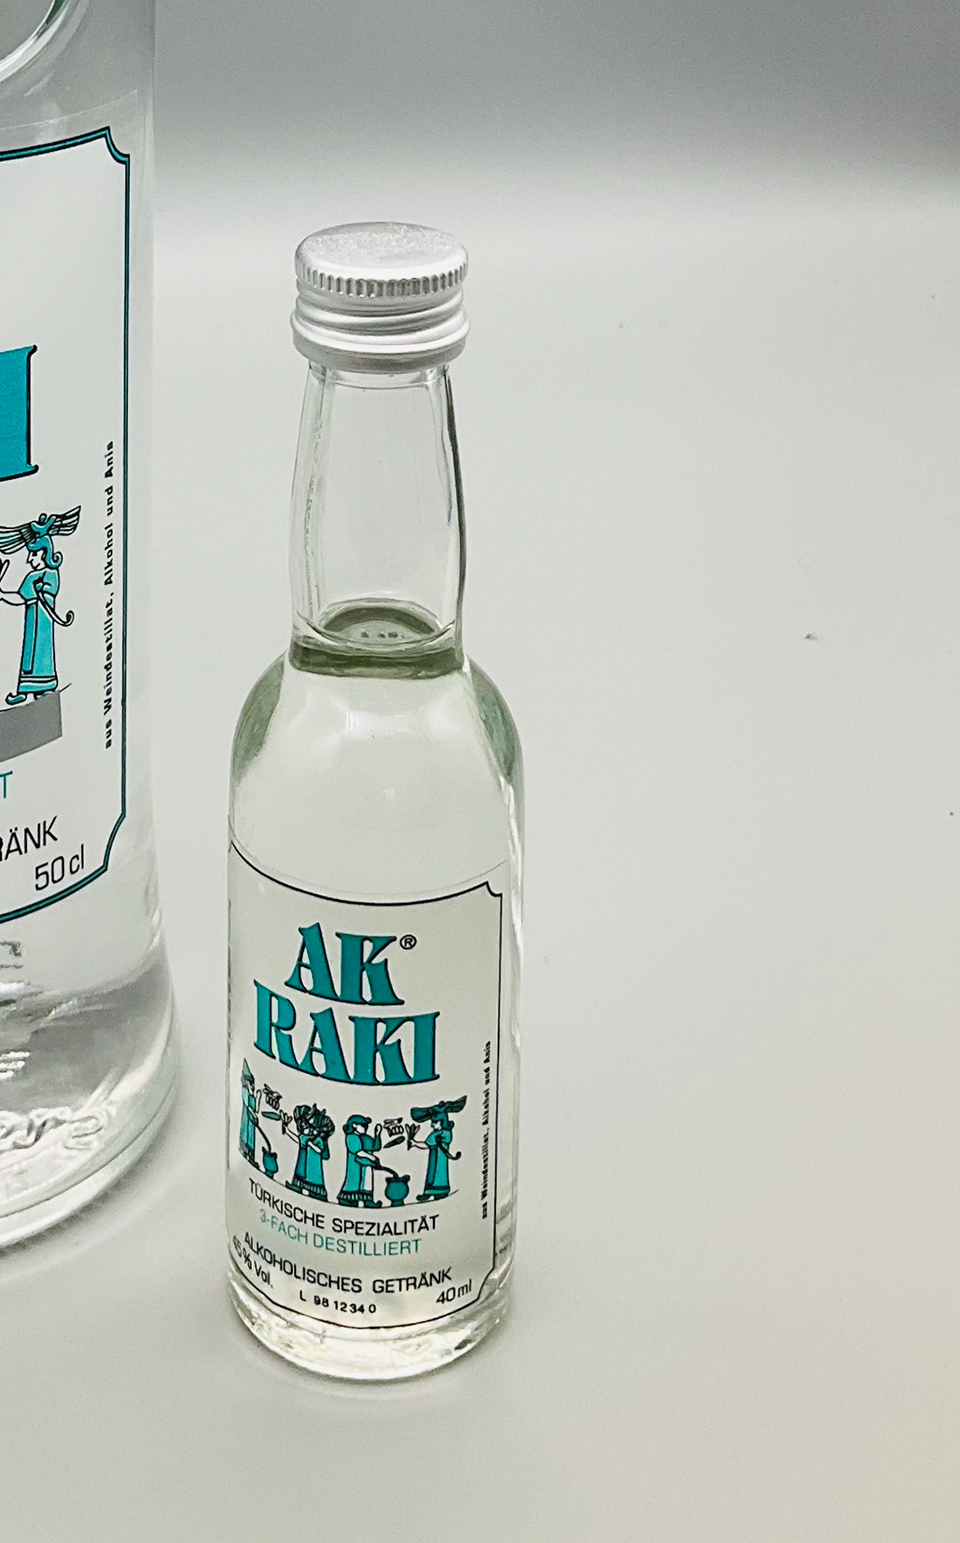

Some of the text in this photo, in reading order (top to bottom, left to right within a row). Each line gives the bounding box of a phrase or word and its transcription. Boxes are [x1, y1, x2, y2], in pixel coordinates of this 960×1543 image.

[103, 441, 114, 749] aus Weindestillat, Alkohol und Anis
[253, 978, 441, 1087] RAKI
[248, 1177, 440, 1237] TÜRKISCHE SPEZIALITÄT
[259, 1208, 423, 1258] 3-FACH DESTILLIERT
[244, 1231, 453, 1295] ALKOHOLISCHES GETRÄNK
[253, 1260, 274, 1289] Vol.
[299, 1289, 307, 1302] L
